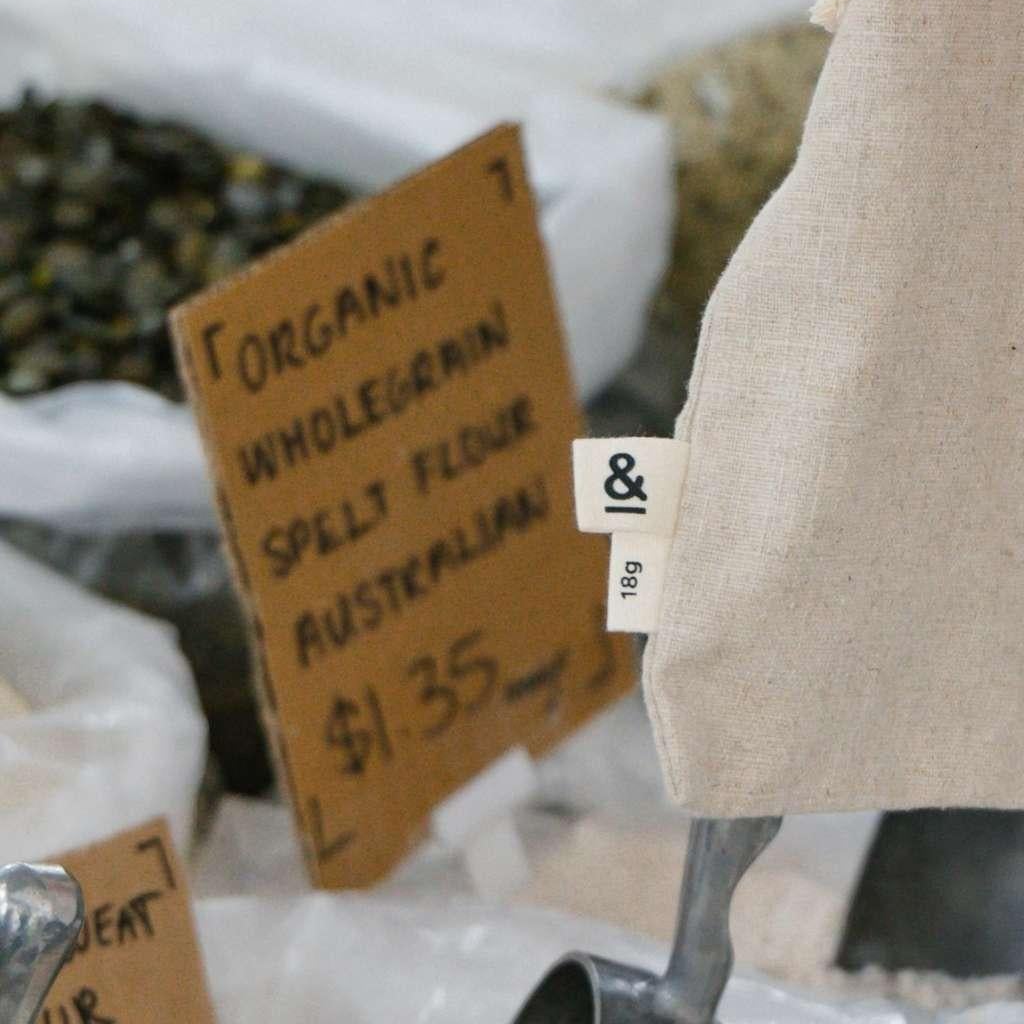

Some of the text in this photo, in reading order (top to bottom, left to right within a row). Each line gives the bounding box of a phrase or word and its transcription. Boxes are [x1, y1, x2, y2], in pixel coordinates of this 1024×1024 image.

[238, 238, 446, 394] ORGANIC
[239, 300, 509, 485] WHOLEGRAIN
[263, 394, 536, 578] SPELT FLOUR
[621, 560, 643, 599] 18g
